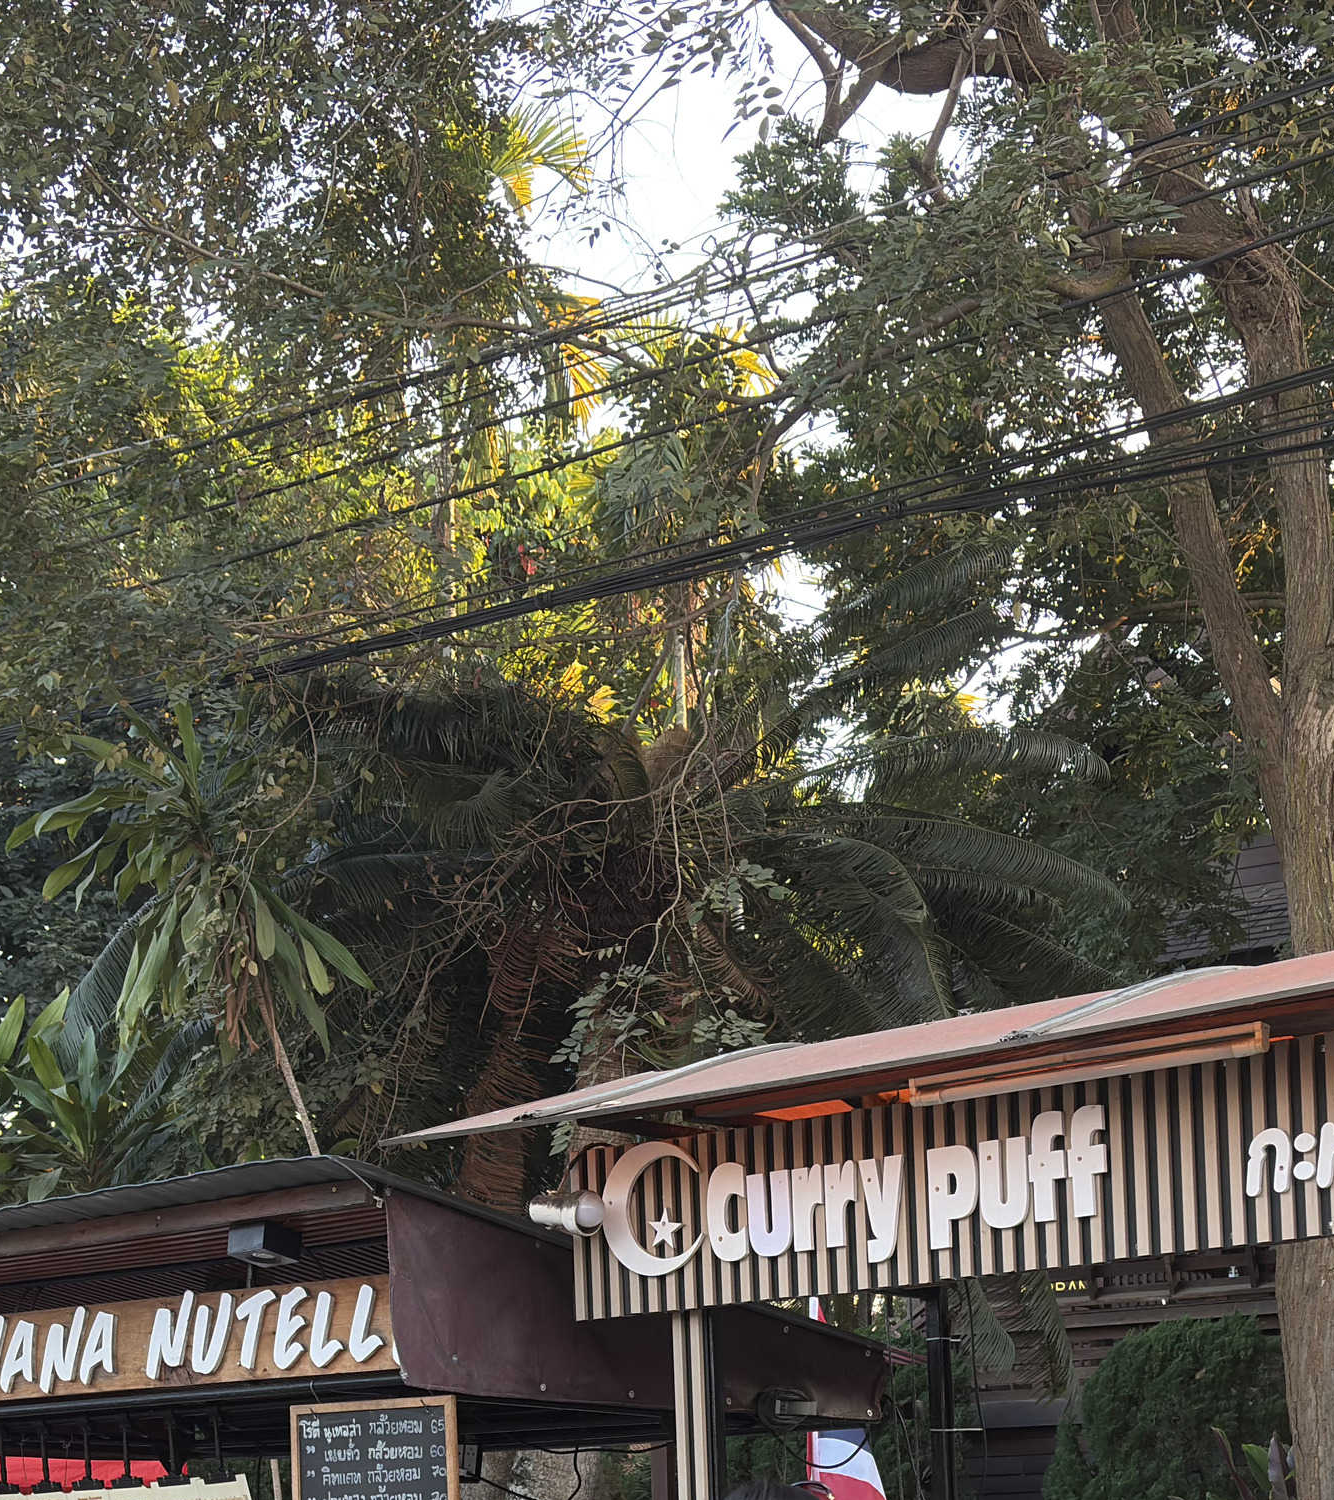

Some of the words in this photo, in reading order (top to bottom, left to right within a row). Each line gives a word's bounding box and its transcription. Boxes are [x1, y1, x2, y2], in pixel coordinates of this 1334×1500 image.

[927, 1105, 1107, 1250] puff
[145, 1283, 398, 1381] NUTELL
[299, 1419, 320, 1439] โรตี
